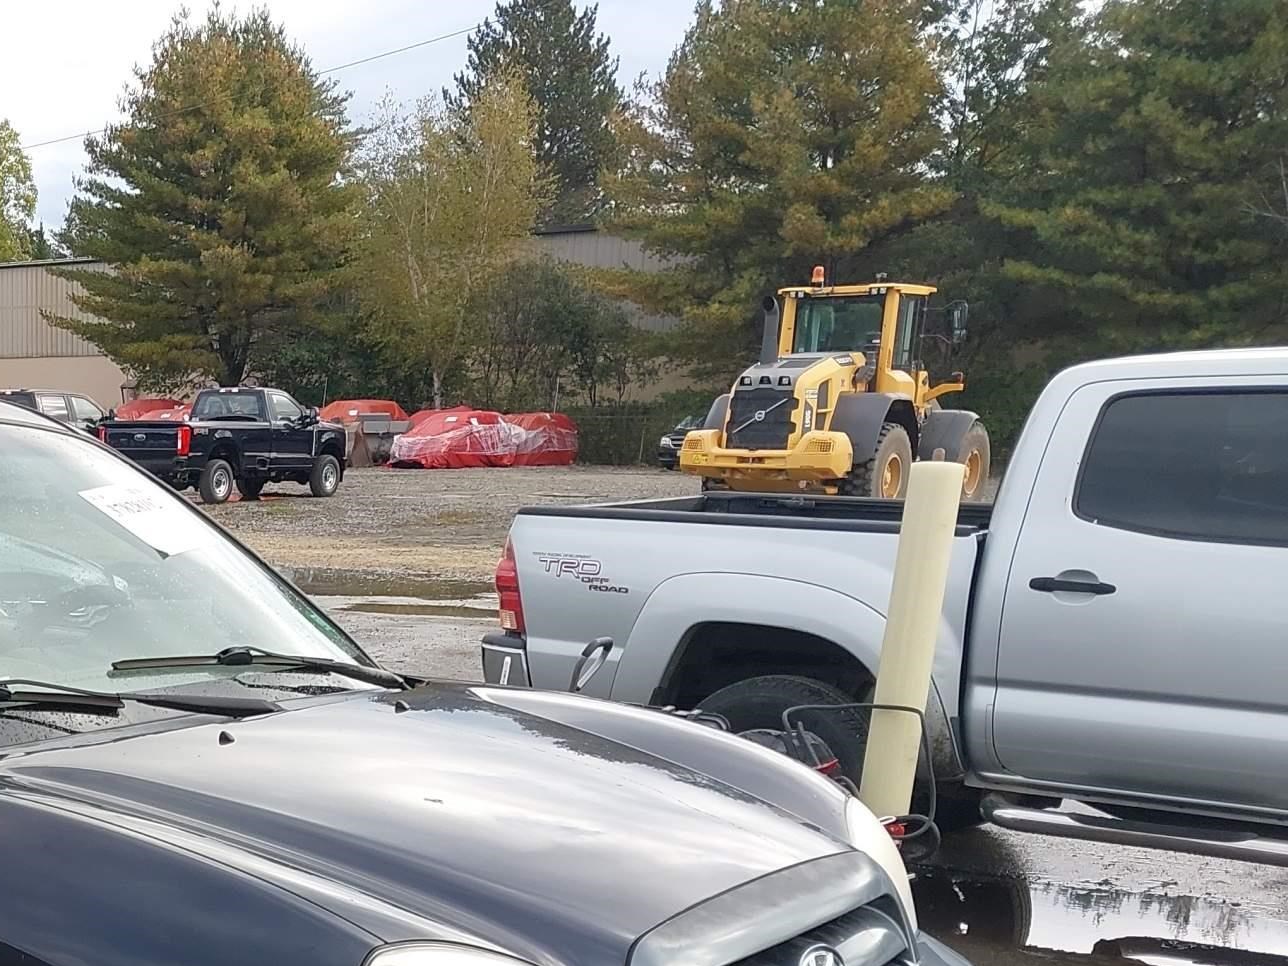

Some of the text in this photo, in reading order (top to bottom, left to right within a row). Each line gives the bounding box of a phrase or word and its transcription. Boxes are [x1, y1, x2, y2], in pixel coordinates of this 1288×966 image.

[539, 557, 601, 578] TRD
[581, 576, 609, 584] OFF
[589, 585, 629, 594] ROAD
